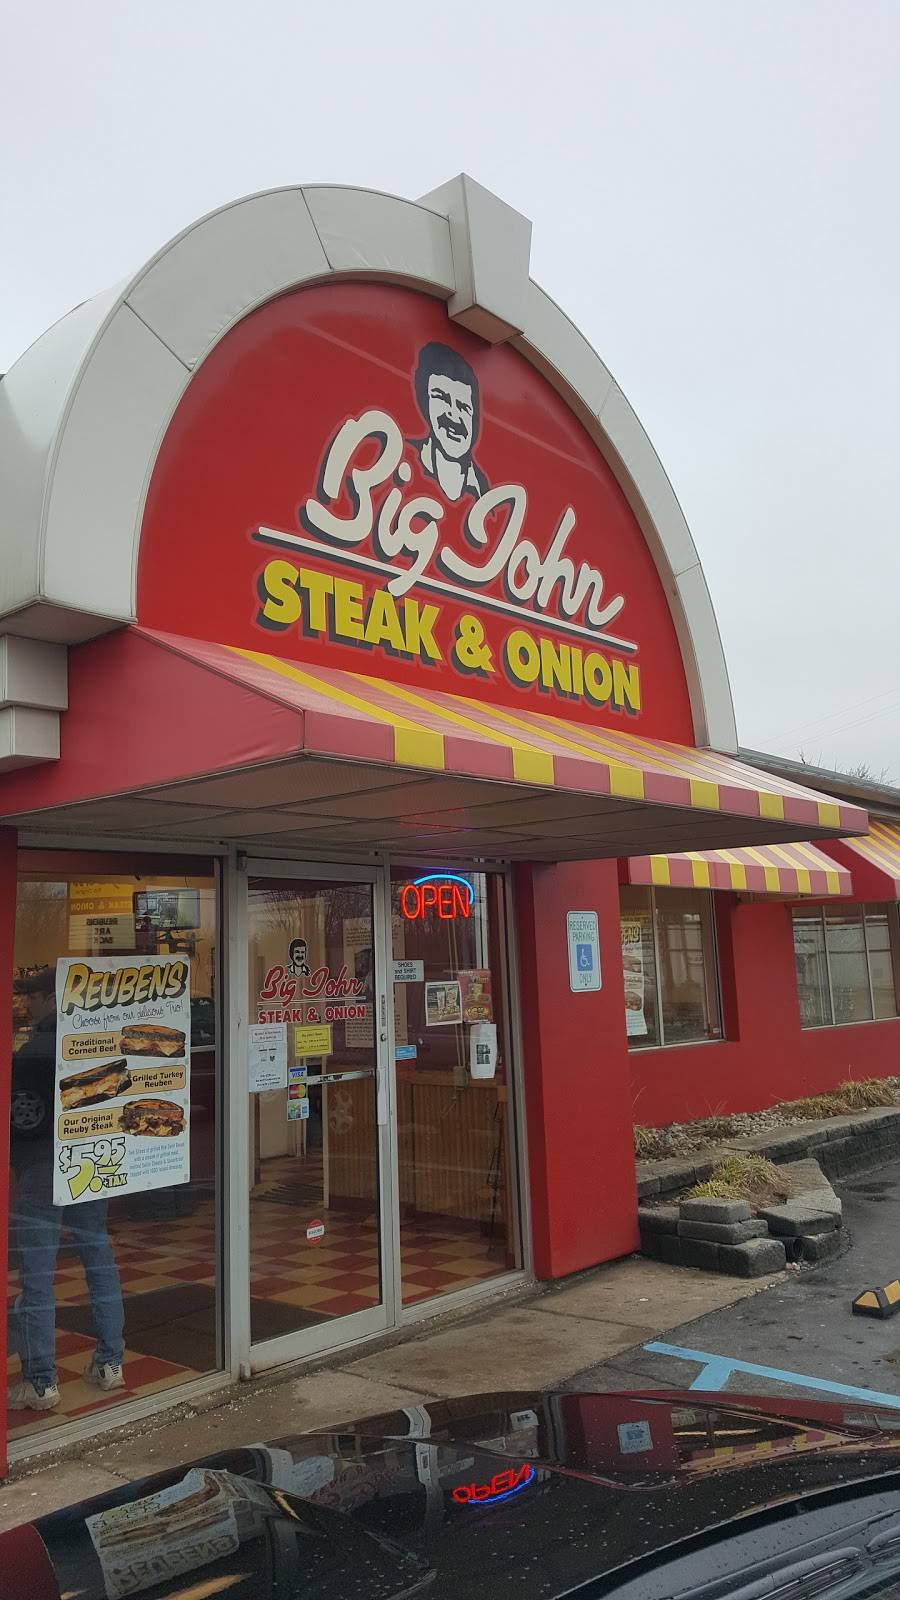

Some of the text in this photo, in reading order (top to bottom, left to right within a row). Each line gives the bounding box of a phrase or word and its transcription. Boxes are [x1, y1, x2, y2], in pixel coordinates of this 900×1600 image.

[302, 410, 625, 625] Big John
[260, 560, 642, 712] STEAK & ONION
[401, 884, 470, 920] OPEN
[569, 921, 596, 930] RESERVED
[572, 932, 595, 942] PARKING
[61, 961, 188, 1015] REUBENS
[260, 965, 363, 1008] Big John
[72, 1013, 101, 1030] Choose
[103, 1013, 120, 1031] from
[122, 1011, 135, 1020] our
[258, 1009, 302, 1024] STEAK
[307, 1007, 318, 1022] &
[325, 1005, 367, 1020] ONION
[68, 1044, 117, 1055] Corned Beef
[71, 1037, 114, 1047] Traditional
[132, 1071, 184, 1082] Grilled Turkey
[144, 1080, 173, 1088] Reuben
[64, 1113, 113, 1126] Our Original
[63, 1121, 113, 1135] Reuby Steak
[59, 1137, 126, 1200] $5.95
